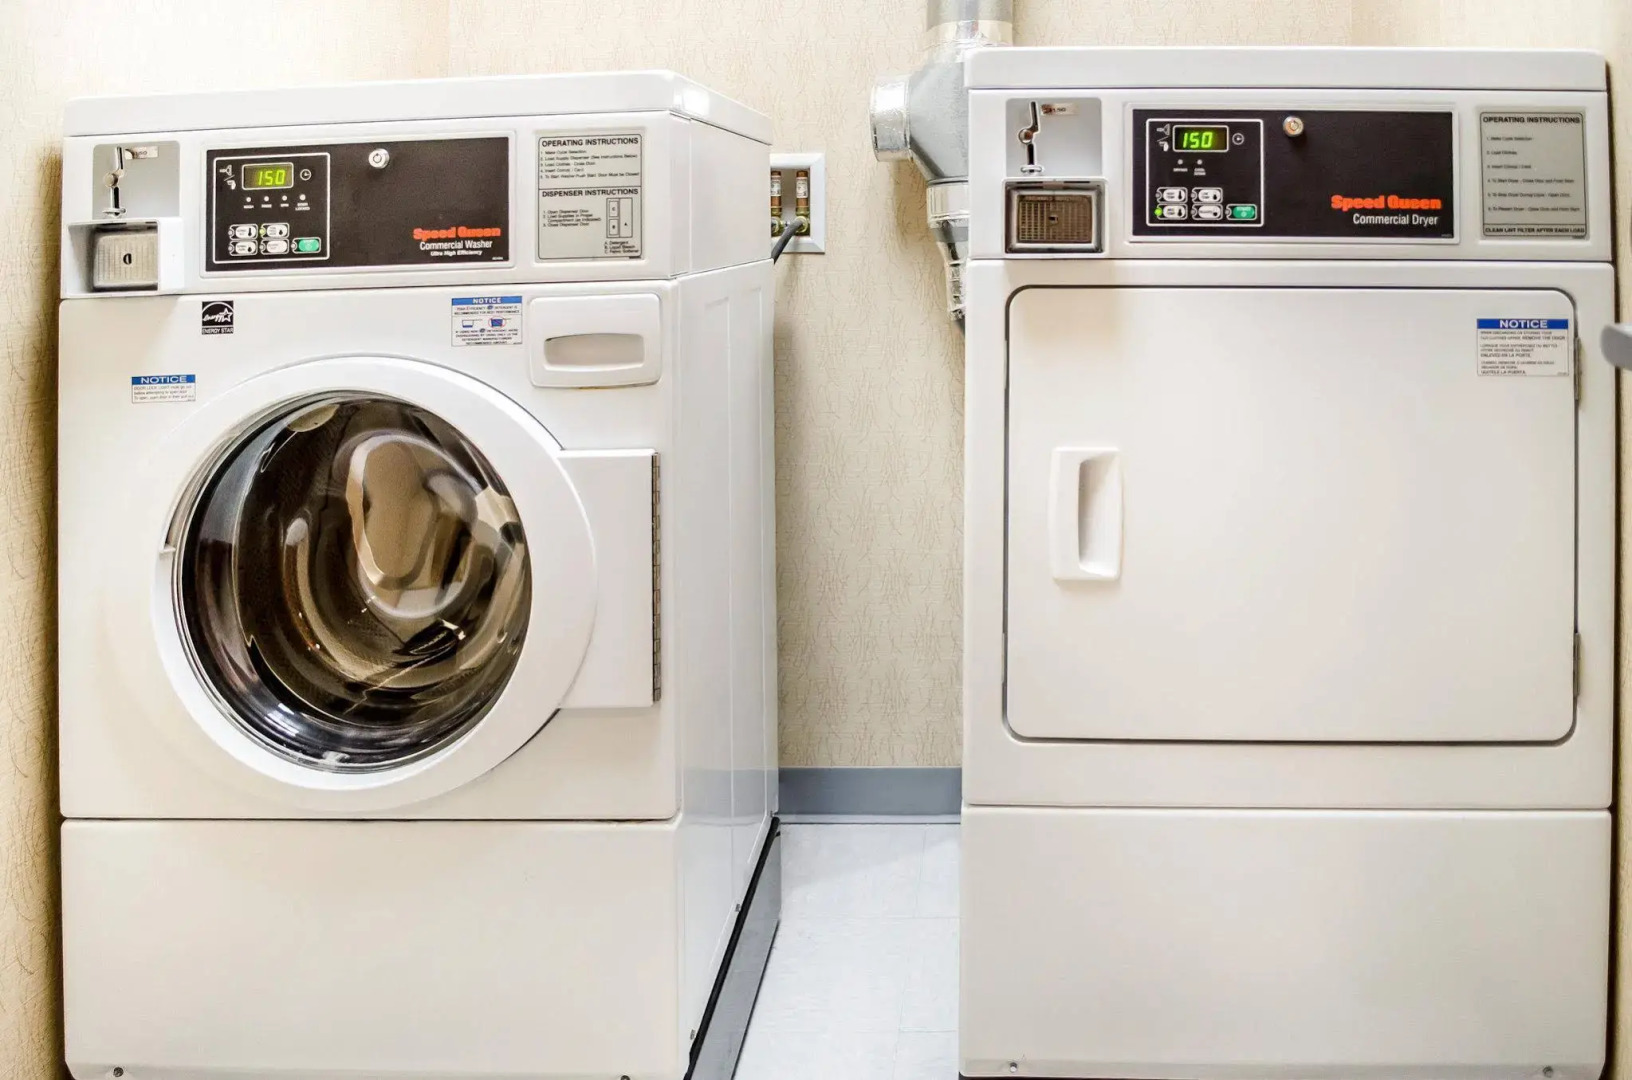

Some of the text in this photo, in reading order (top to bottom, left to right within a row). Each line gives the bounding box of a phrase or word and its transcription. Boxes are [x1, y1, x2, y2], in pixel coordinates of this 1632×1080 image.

[1183, 132, 1212, 148] 150
[259, 170, 285, 185] 150
[1331, 195, 1441, 212] Speed Queen
[1353, 213, 1438, 227] Commercial Dryer
[413, 226, 501, 241] Speed Queen
[420, 240, 493, 250] Commercial Washer
[1500, 320, 1548, 328] NOTICE
